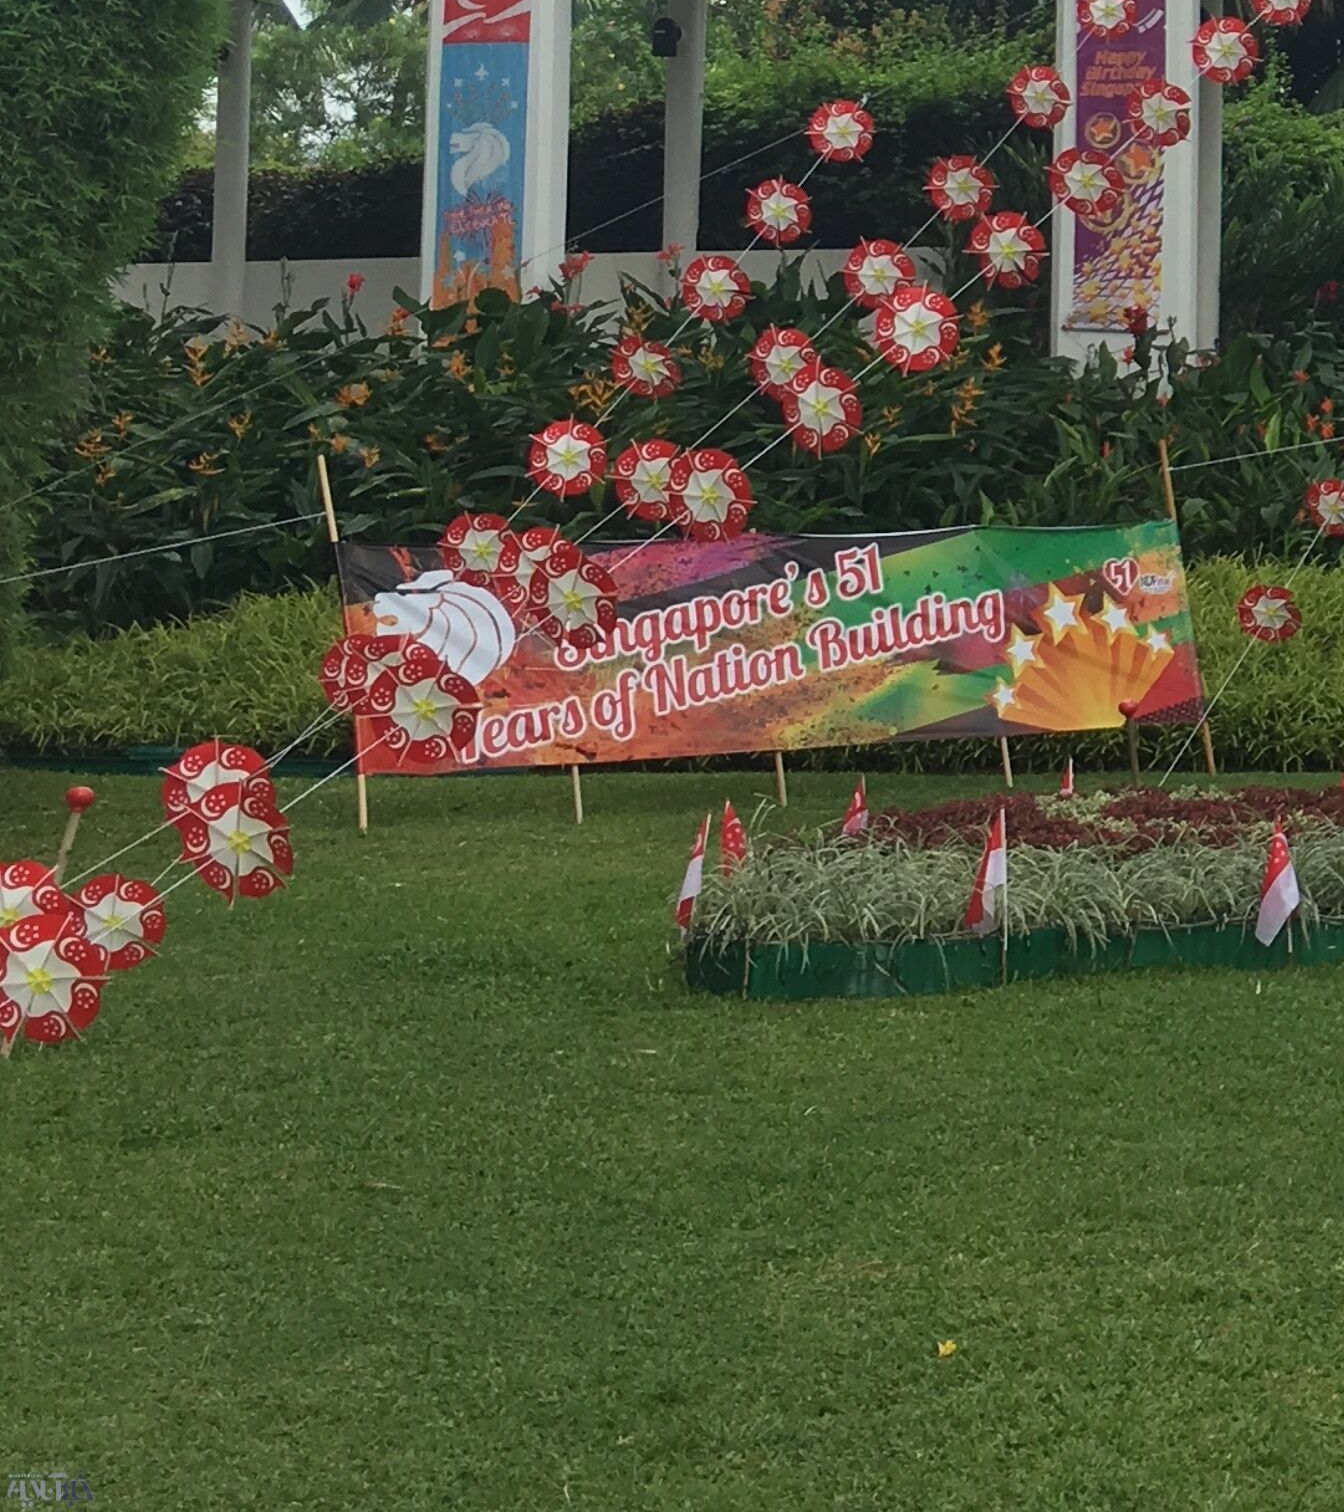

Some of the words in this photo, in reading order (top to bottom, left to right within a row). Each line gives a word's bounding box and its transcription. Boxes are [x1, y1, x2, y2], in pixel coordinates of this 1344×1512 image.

[834, 542, 884, 601] 51
[1109, 562, 1131, 590] 51
[592, 668, 638, 742] of
[644, 643, 805, 716] Nation
[807, 589, 1005, 672] Building
